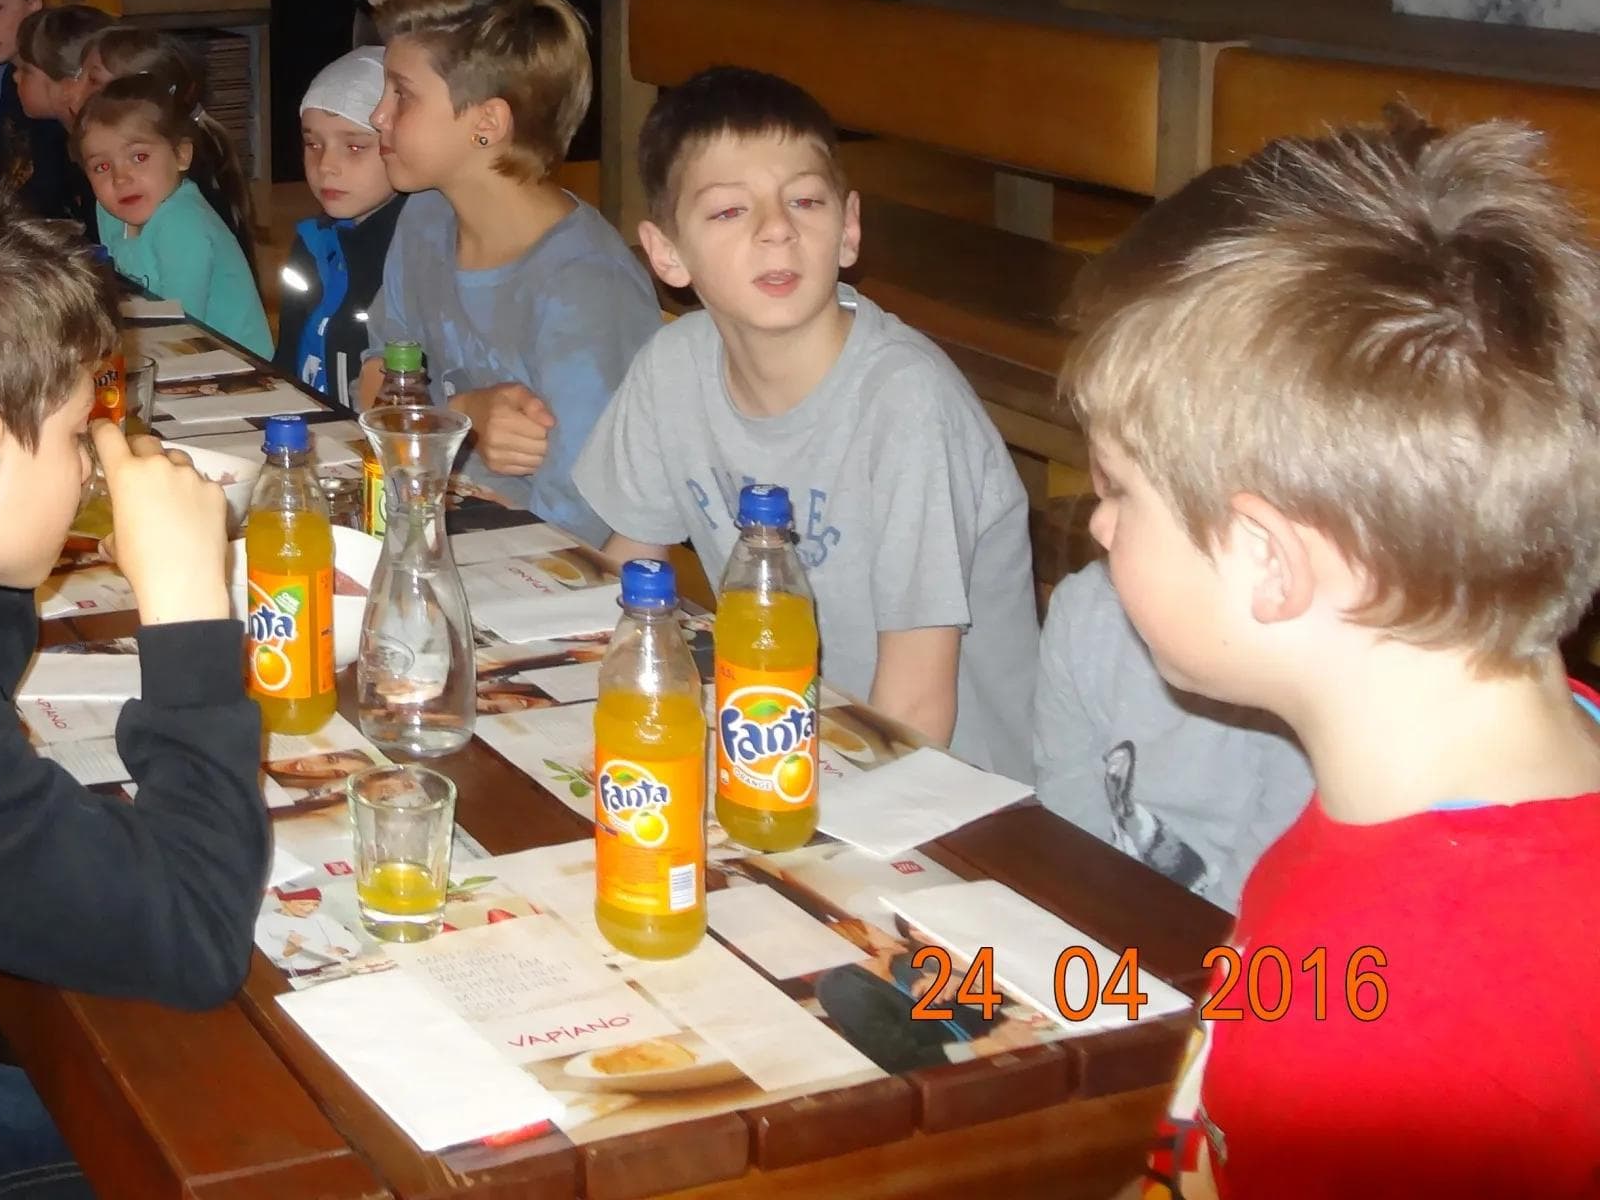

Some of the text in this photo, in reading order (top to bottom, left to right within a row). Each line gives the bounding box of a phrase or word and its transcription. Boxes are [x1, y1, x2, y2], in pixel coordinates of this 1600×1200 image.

[720, 707, 816, 763] Fanta
[599, 772, 670, 811] Fanta
[508, 1016, 632, 1049] VAPIANO
